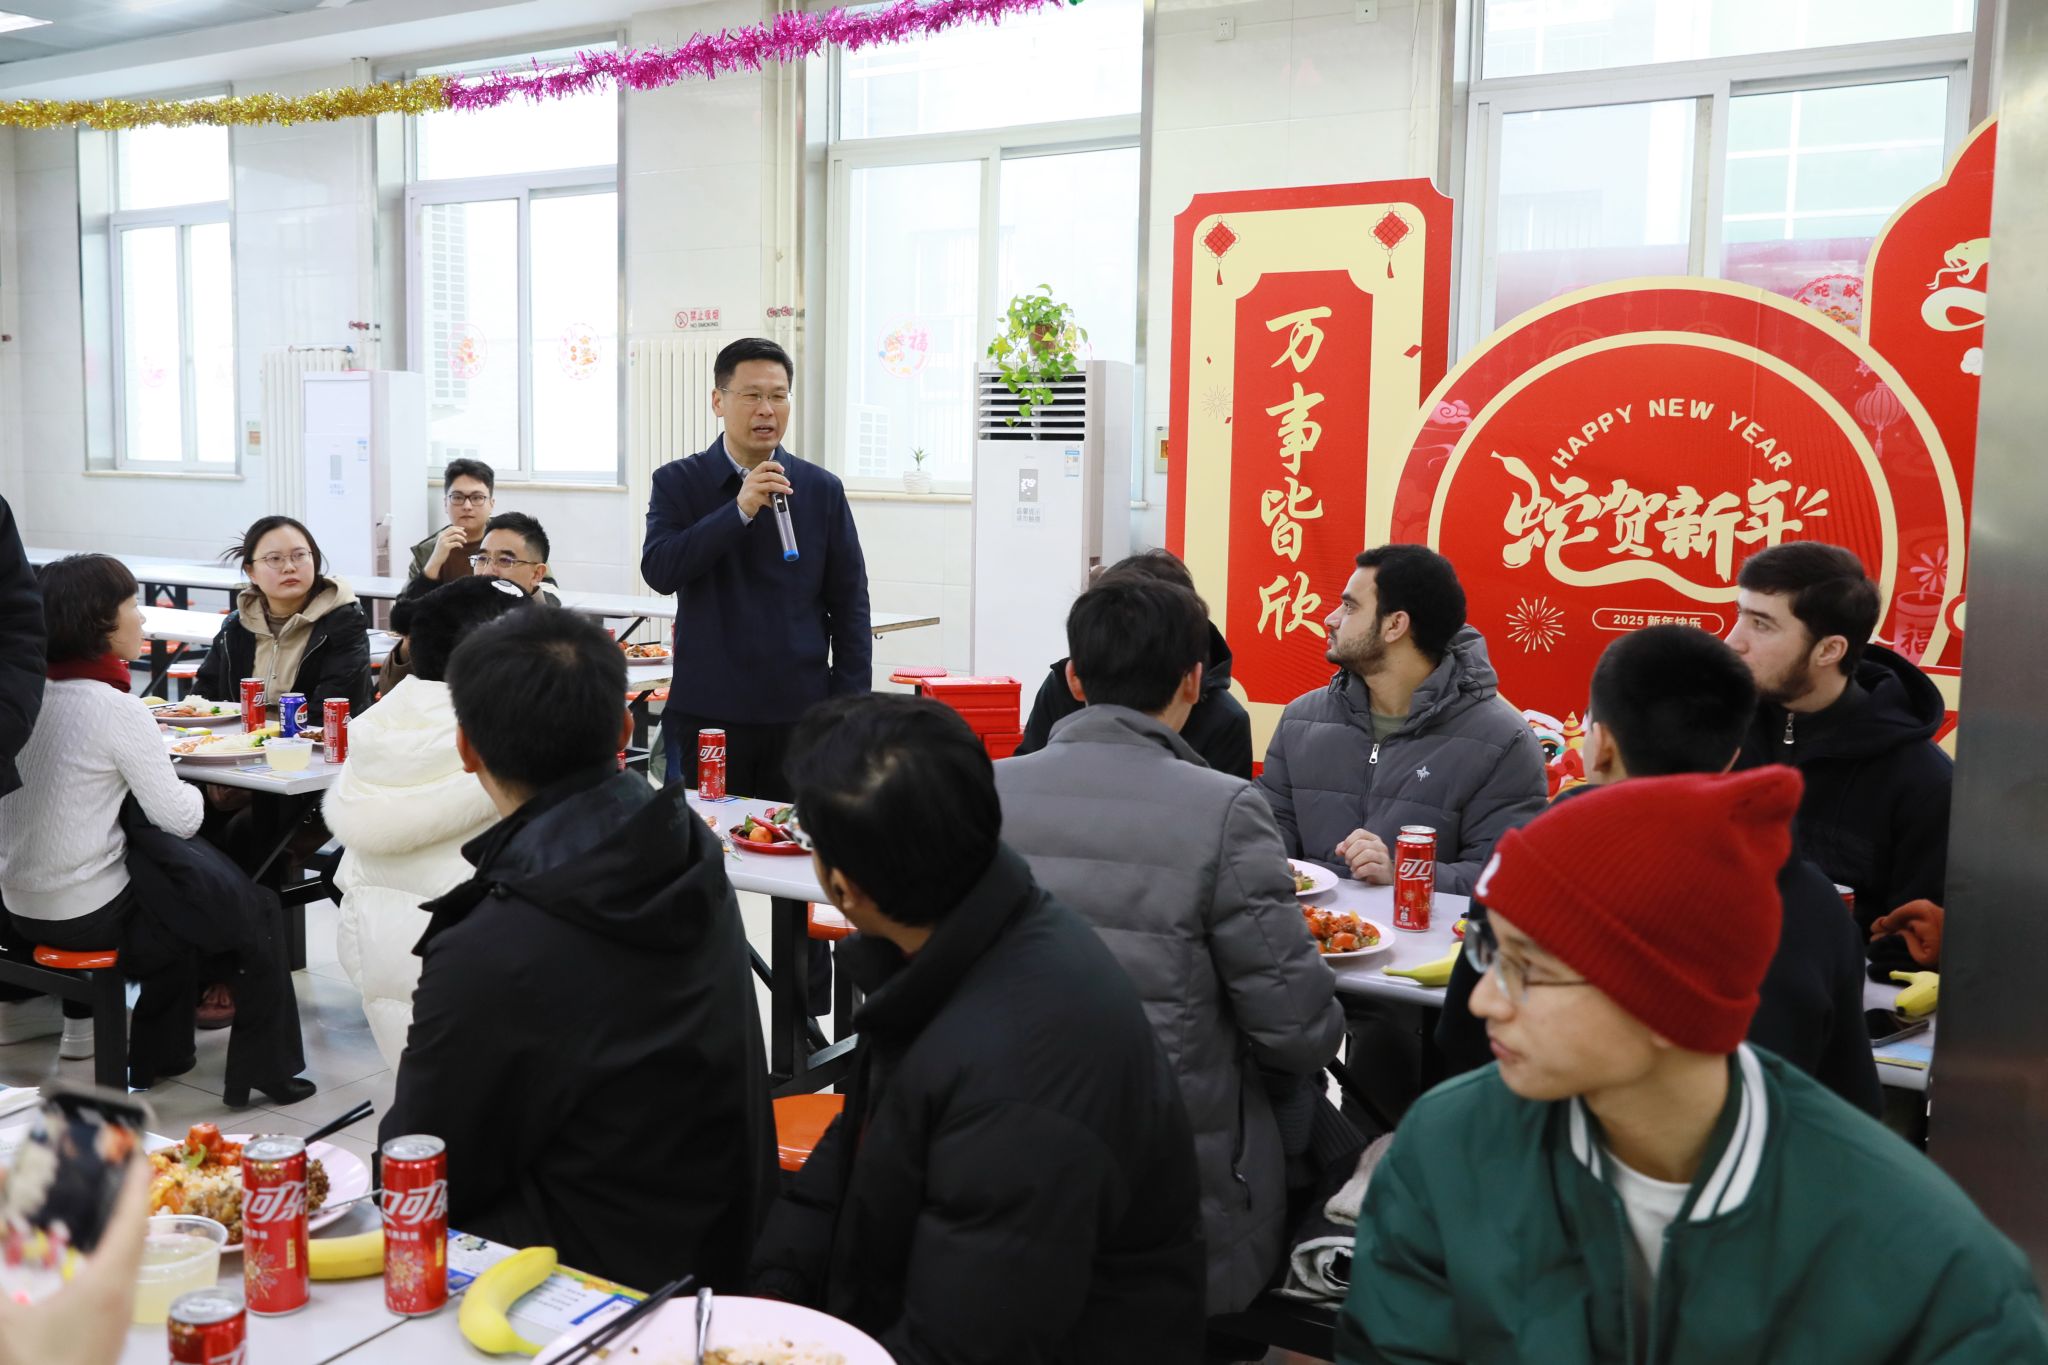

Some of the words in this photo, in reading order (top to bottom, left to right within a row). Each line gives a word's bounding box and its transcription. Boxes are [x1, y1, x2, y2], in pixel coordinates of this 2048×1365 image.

[690, 309, 719, 321] 禁止吸烟
[1551, 405, 1633, 469] HAPPY
[1648, 398, 1715, 421] NEW
[1728, 411, 1793, 472] YEAR
[1257, 306, 1332, 641] 万事皆欣
[1500, 465, 1806, 586] 蛇贺新年
[1613, 614, 1644, 626] 2025
